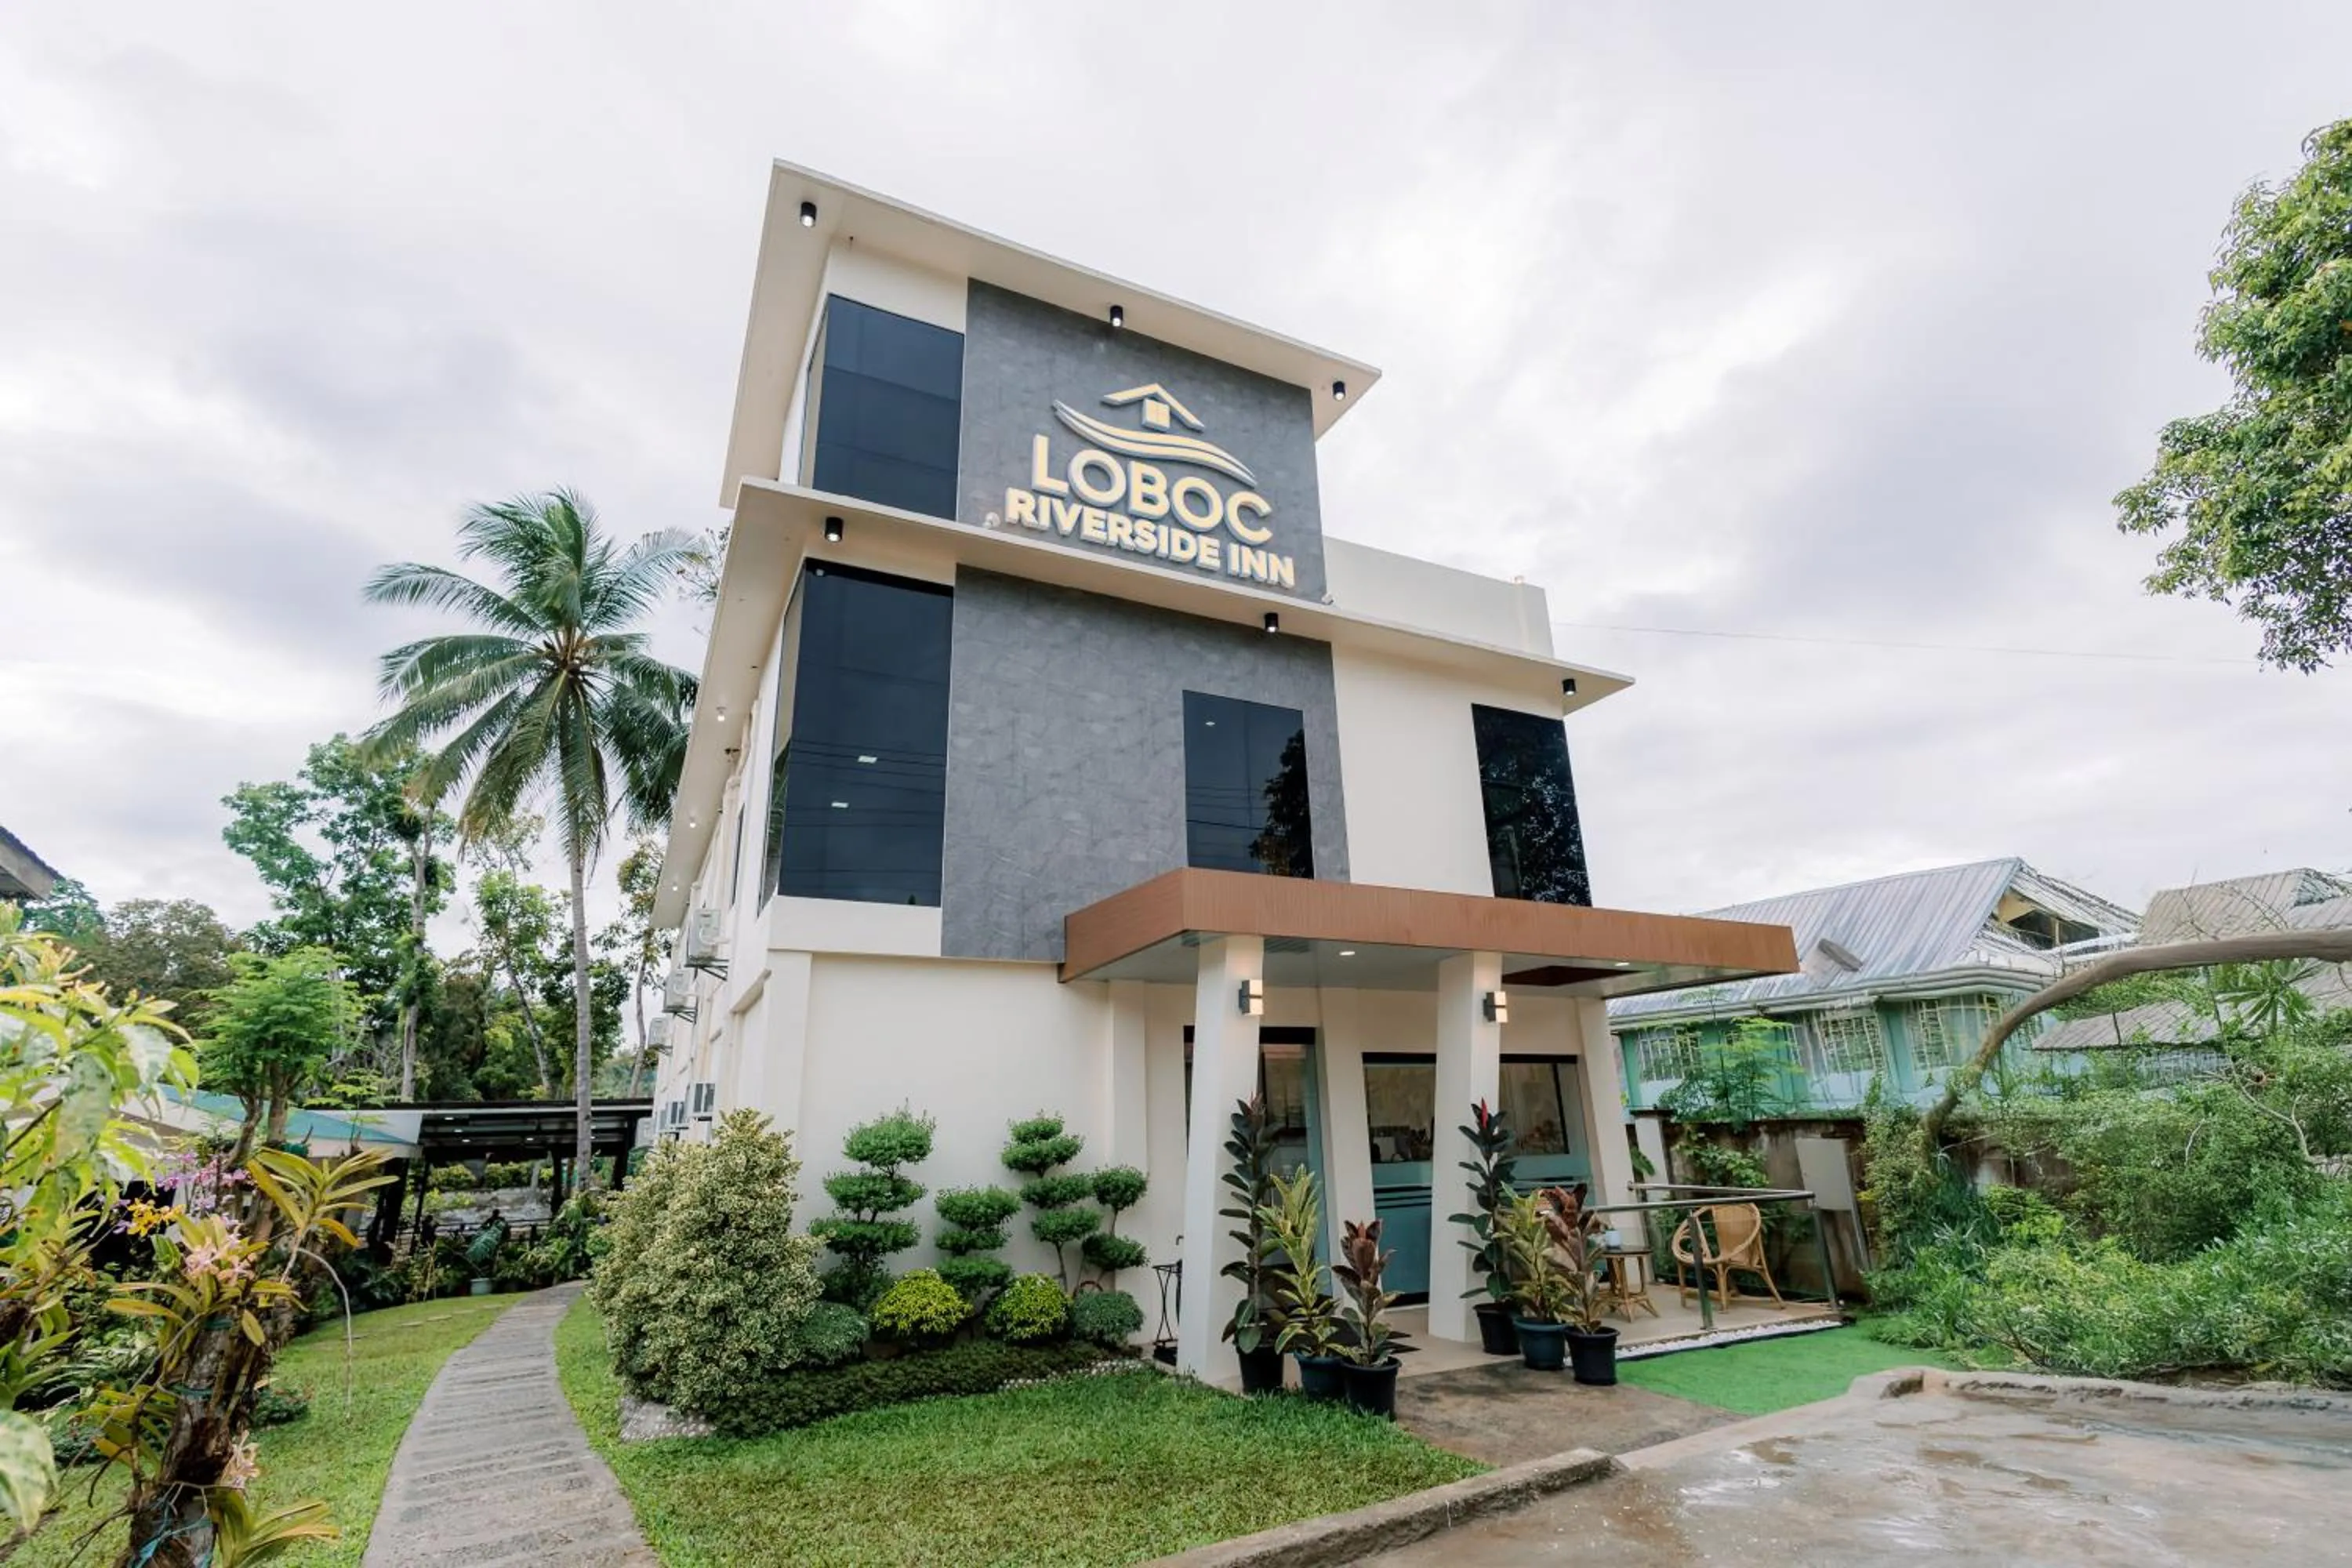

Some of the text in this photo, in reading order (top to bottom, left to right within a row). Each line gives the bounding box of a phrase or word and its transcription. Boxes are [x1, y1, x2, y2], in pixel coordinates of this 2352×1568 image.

[1005, 487, 1294, 589] RIVERSIDE INN
[1032, 434, 1272, 544] LOBOC
